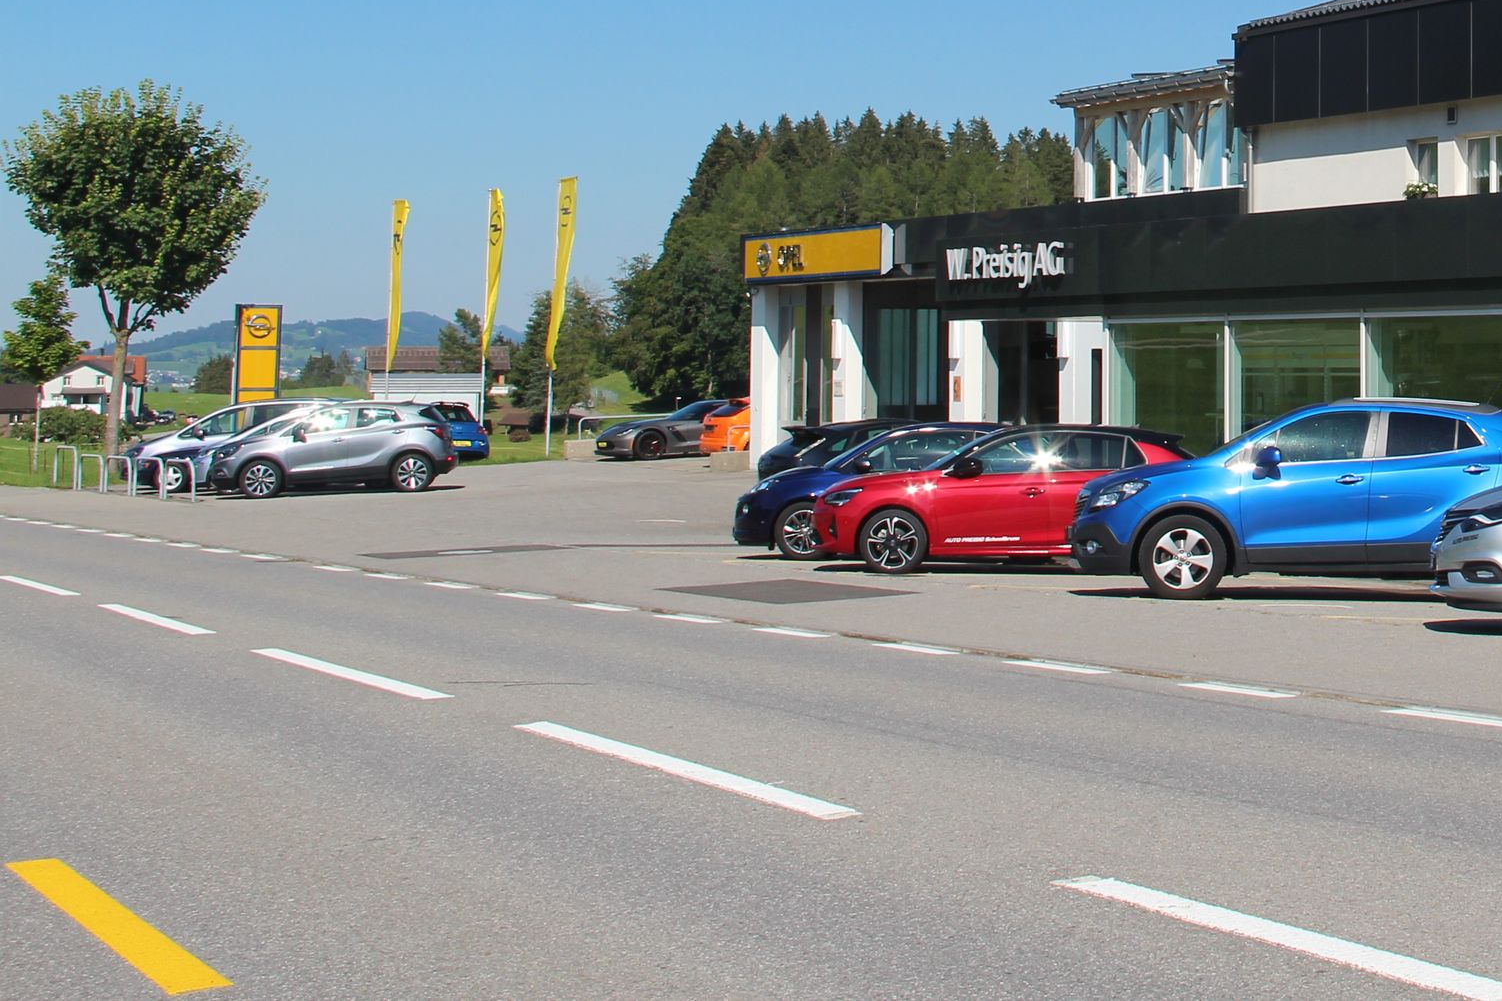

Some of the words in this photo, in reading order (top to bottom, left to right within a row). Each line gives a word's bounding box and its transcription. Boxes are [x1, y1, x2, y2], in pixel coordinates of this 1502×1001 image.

[946, 248, 971, 280] W.
[972, 243, 1032, 288] Preisig
[1033, 241, 1065, 276] AG
